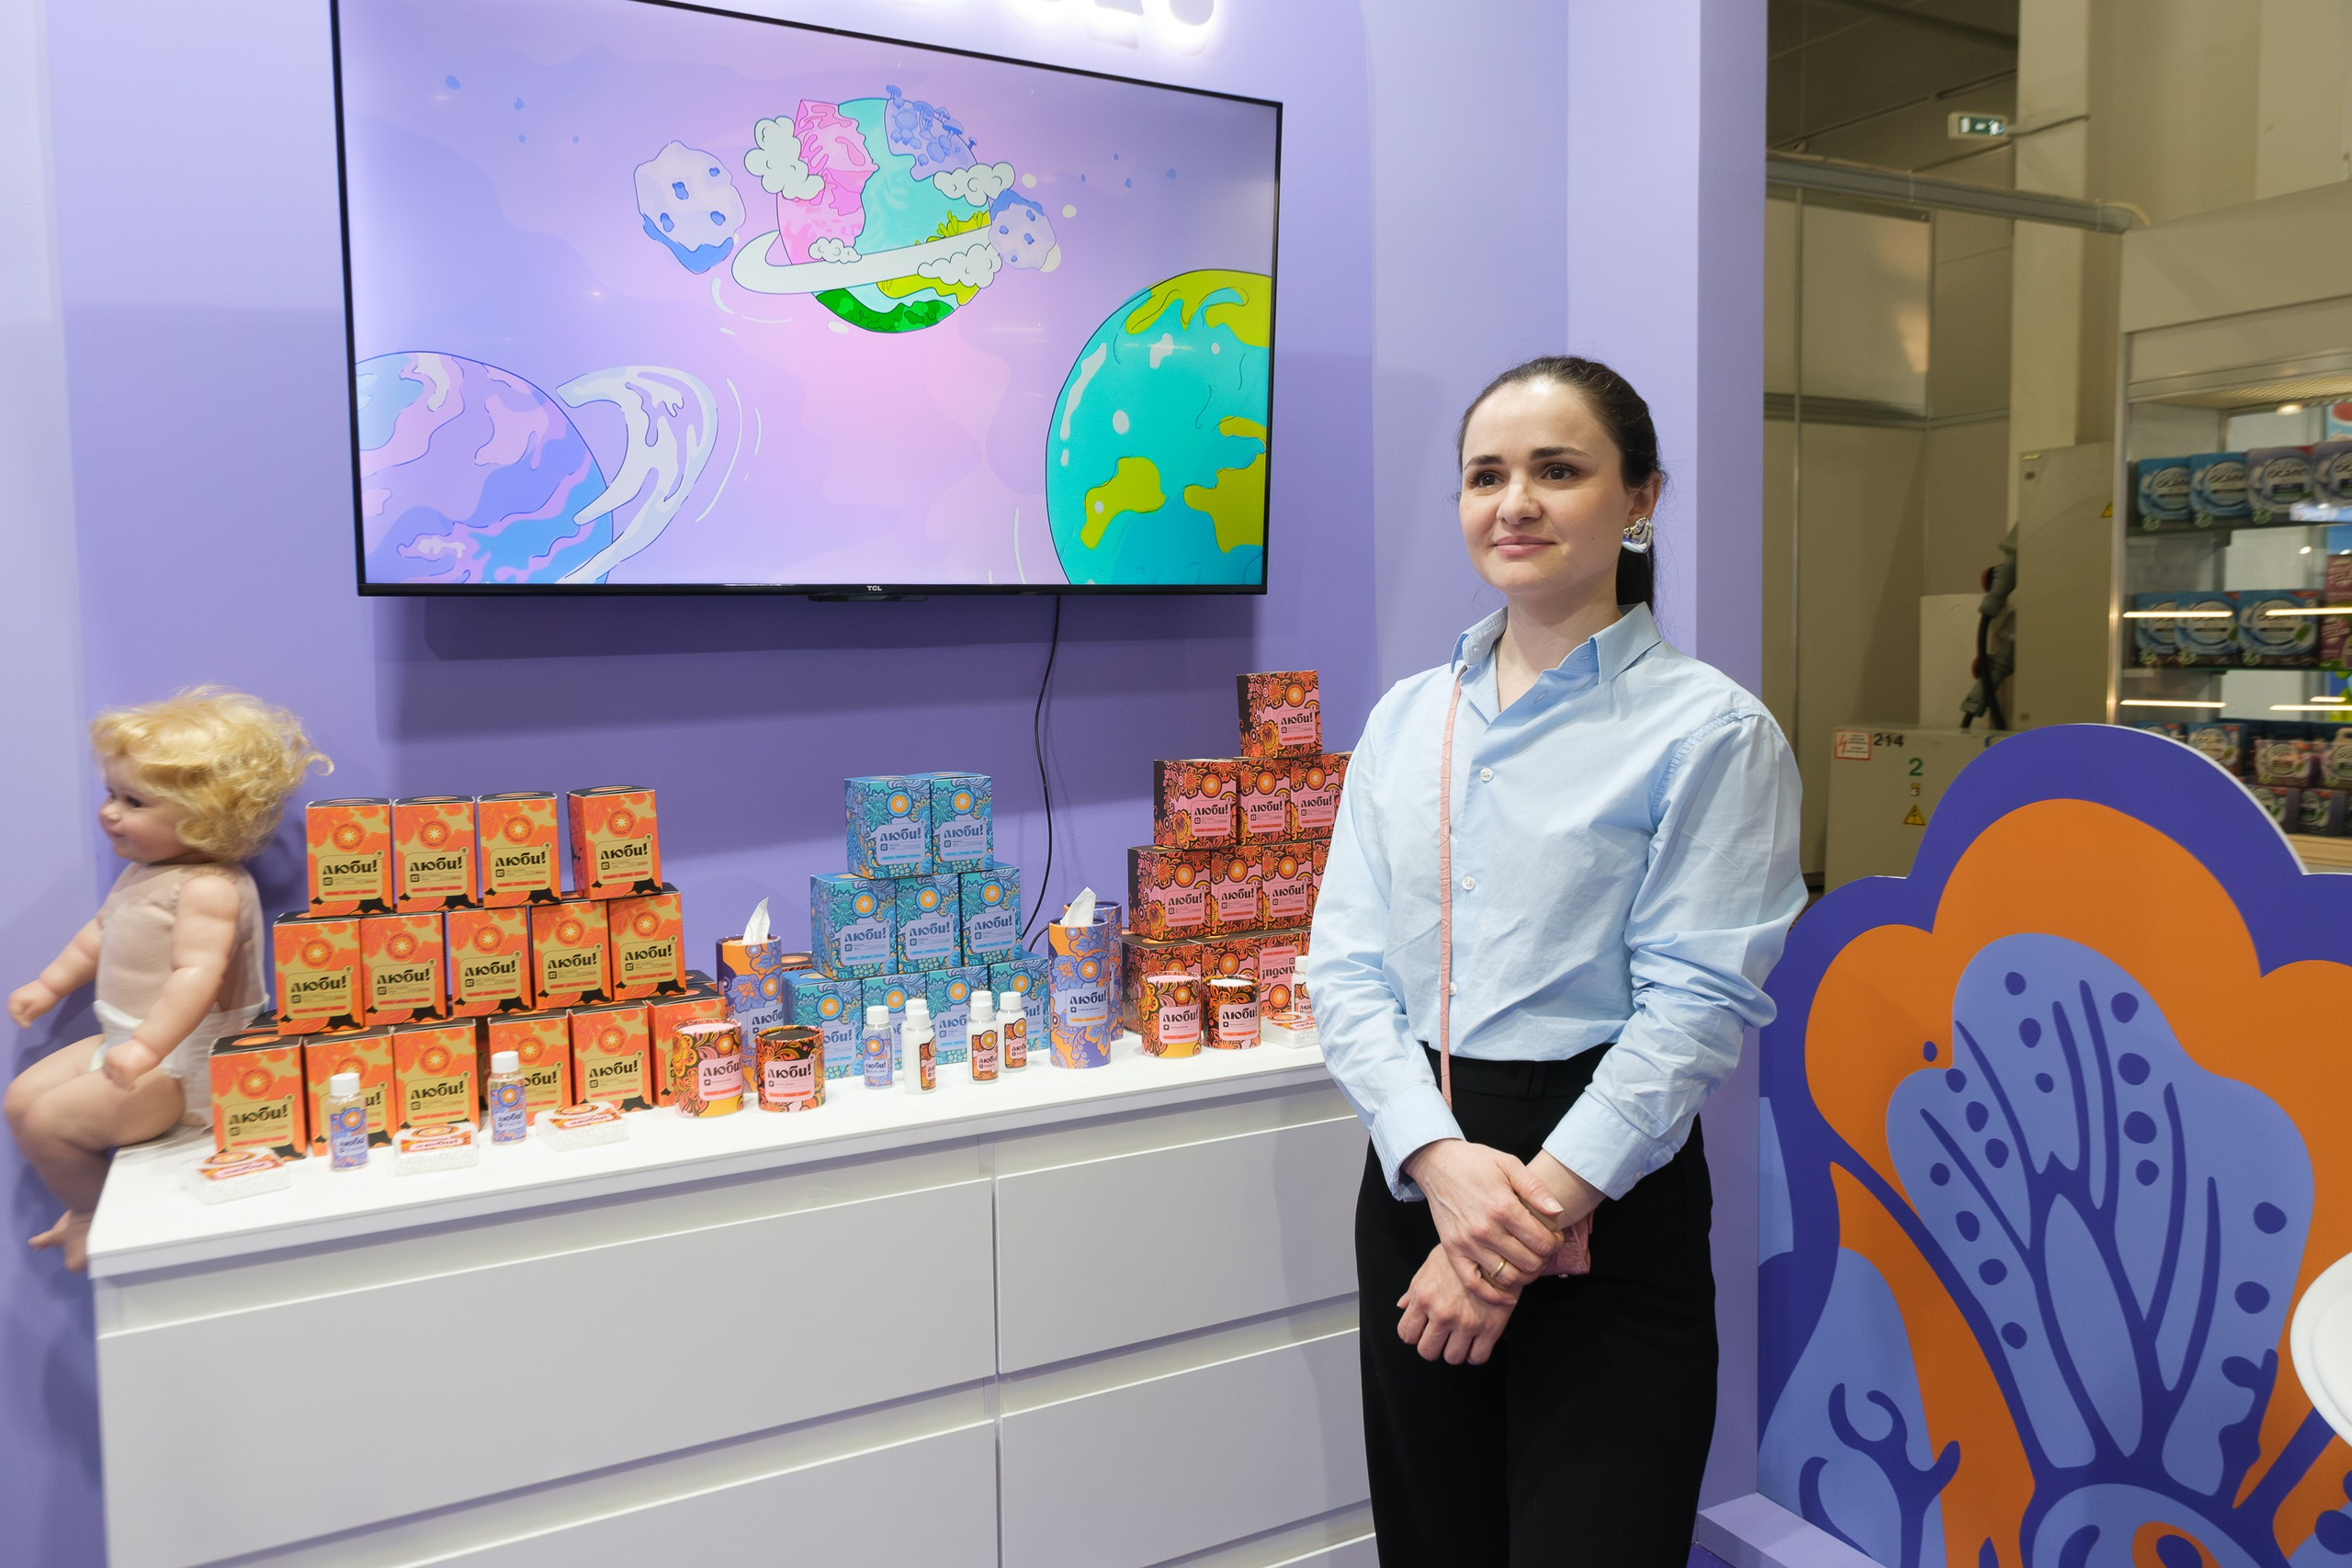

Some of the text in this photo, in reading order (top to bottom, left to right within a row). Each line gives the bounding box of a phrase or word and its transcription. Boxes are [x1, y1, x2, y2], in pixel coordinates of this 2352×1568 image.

[1281, 712, 1313, 725] люби!
[1872, 732, 1904, 747] 214
[1908, 757, 1923, 776] 2
[1250, 801, 1283, 813] люби!
[1301, 795, 1332, 807] люби!
[1194, 804, 1228, 816] люби!
[880, 828, 922, 841] люби!
[944, 824, 984, 838] люби!
[495, 851, 546, 866] люби!
[601, 842, 648, 860] люби!
[322, 859, 378, 874] люби!
[410, 856, 462, 872] люби!
[1221, 887, 1254, 900] люби!
[1272, 885, 1305, 897] люби!
[1168, 893, 1203, 906] люби!
[910, 921, 950, 936] люби!
[974, 915, 1012, 931] люби!
[844, 927, 887, 942] люби!
[625, 944, 673, 961] люби!
[464, 960, 515, 976] люби!
[548, 953, 597, 969] люби!
[377, 968, 430, 984] люби!
[290, 976, 346, 993] люби!
[1070, 989, 1107, 1005] люби!
[939, 1013, 967, 1029] люб
[1163, 1007, 1199, 1022] люби!
[1223, 1007, 1258, 1020] люби!
[589, 1060, 638, 1077] люби!
[767, 1063, 811, 1078] люби!
[411, 1080, 464, 1100] люби!
[229, 1104, 288, 1125] люби!
